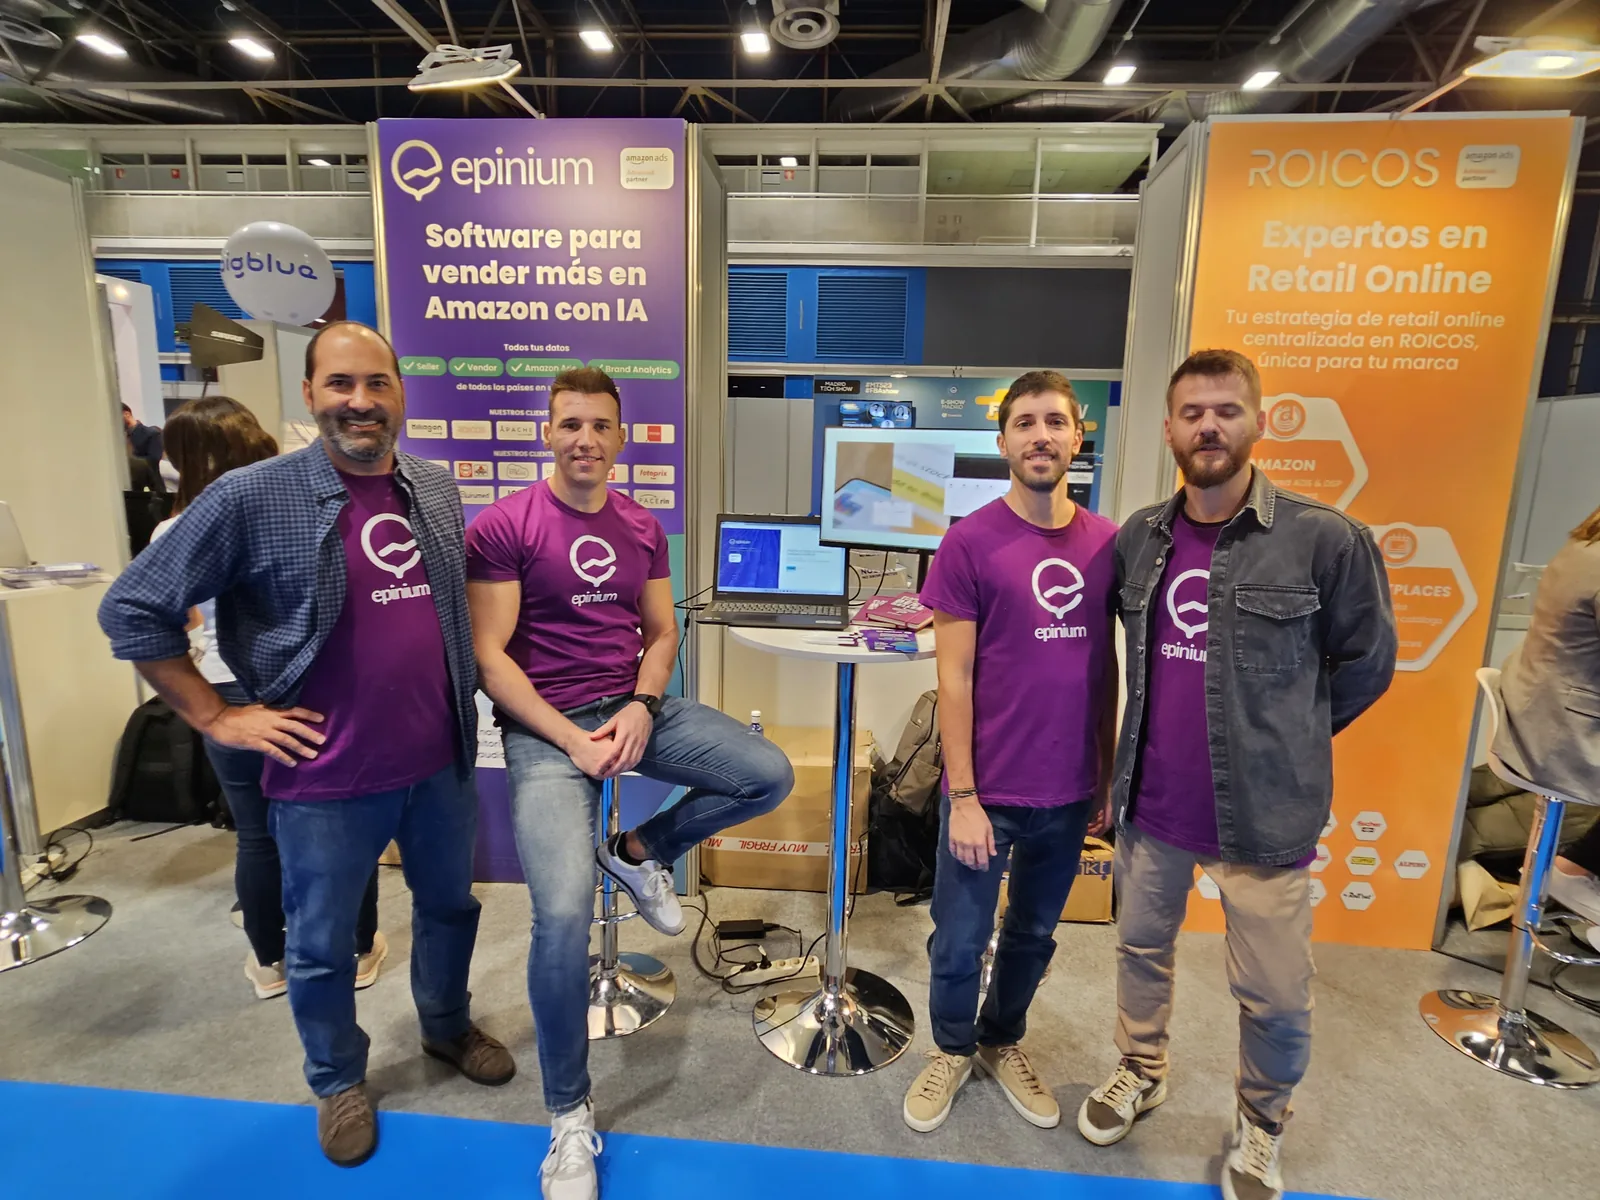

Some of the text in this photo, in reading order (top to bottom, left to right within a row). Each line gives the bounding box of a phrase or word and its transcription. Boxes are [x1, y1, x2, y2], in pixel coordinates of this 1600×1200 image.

[626, 153, 668, 163] amazon ads
[1248, 148, 1441, 188] ROICOS
[451, 147, 593, 193] epinium
[425, 221, 641, 257] Software para
[1262, 220, 1487, 257] Expertos en
[422, 258, 647, 286] vender más en
[1248, 261, 1492, 294] Retail Online
[425, 296, 649, 322] Amazon con IA
[1225, 310, 1505, 331] Tu estrategia de retail online
[503, 343, 570, 352] Todos tus datos
[1242, 331, 1480, 351] centralizada en ROICOS,
[416, 362, 440, 371] Seller
[467, 363, 497, 372] Vendor
[525, 364, 560, 373] Amazon
[605, 365, 672, 375] Brand Analytics
[1257, 352, 1459, 372] única para tu marca
[456, 383, 468, 391] de
[468, 383, 492, 391] todos
[493, 383, 506, 391] los
[372, 583, 431, 605] epinium
[571, 591, 618, 607] epinium
[1034, 623, 1087, 642] epinium
[1161, 641, 1207, 662] epiniu
[738, 840, 809, 853] MUY FRAGIL
